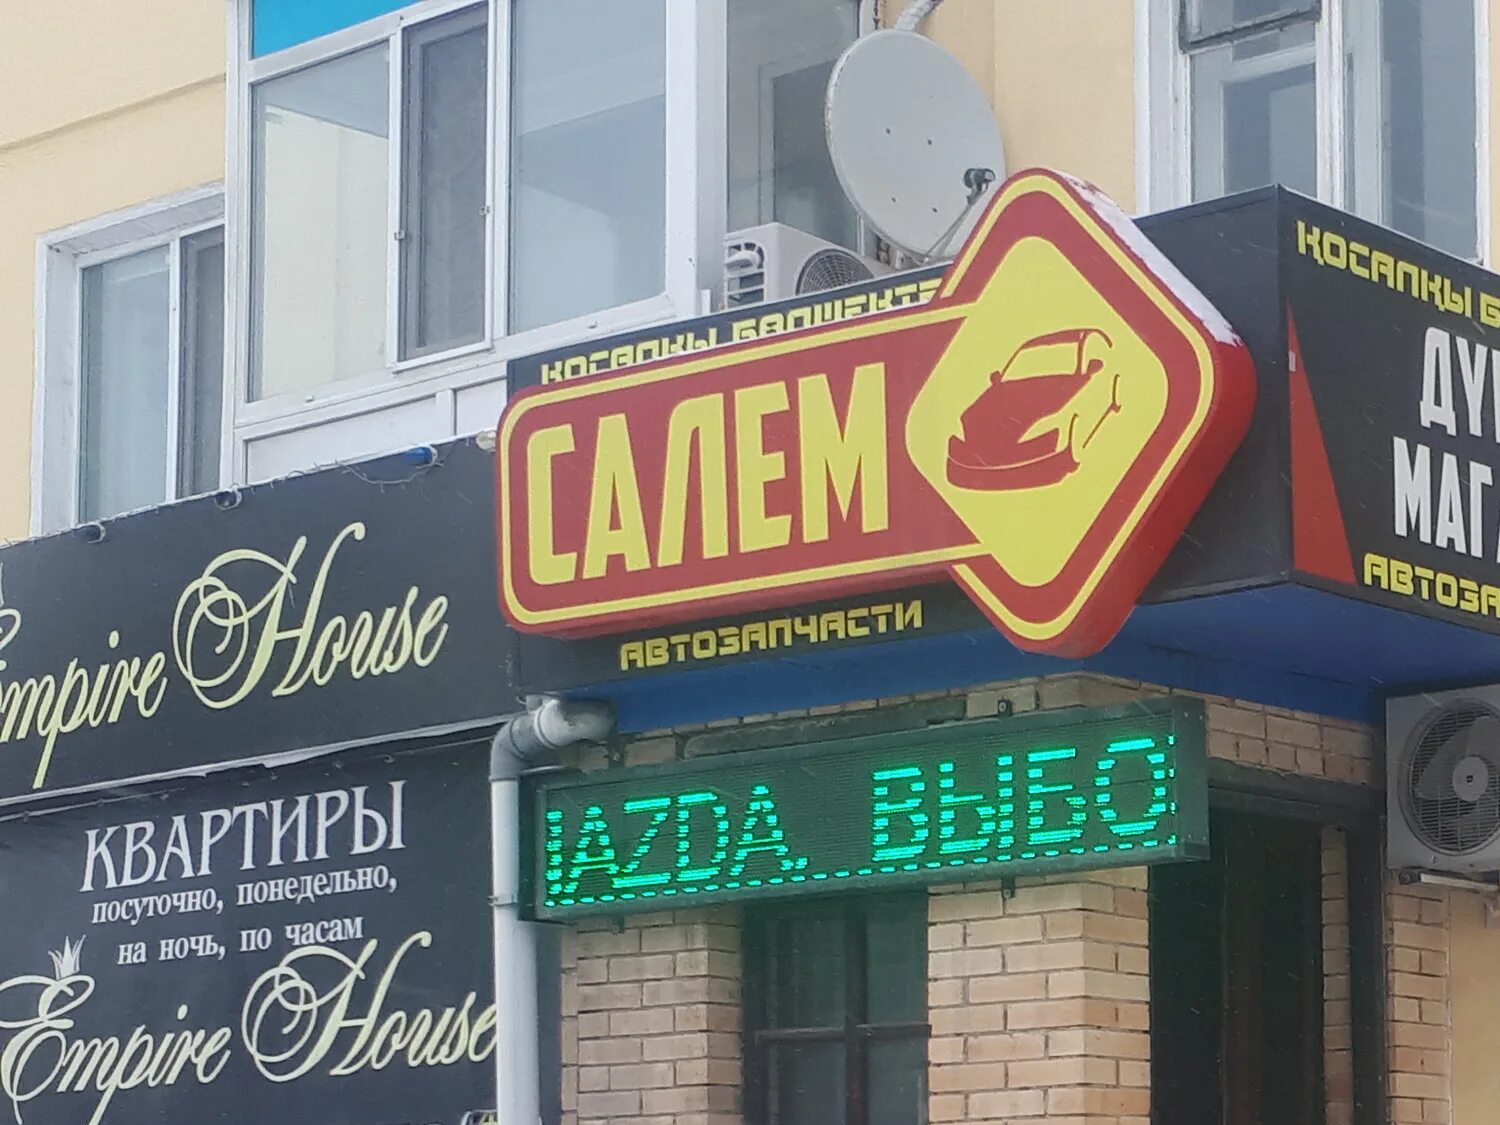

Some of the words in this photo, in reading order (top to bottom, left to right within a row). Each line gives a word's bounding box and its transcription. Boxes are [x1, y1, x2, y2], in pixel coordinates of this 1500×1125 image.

[528, 362, 888, 586] САЛЕМ
[173, 522, 448, 709] House
[619, 600, 923, 671] АВТОЗАПЧАСТИ
[80, 781, 405, 892] КВАРТИРЫ
[873, 735, 1175, 860] ВЫБО
[92, 887, 224, 924] посуточно,
[237, 864, 397, 906] понедельно,
[117, 941, 147, 965] на
[159, 933, 226, 961] ночь,
[240, 928, 272, 952] по
[285, 916, 364, 947] часам
[242, 931, 497, 1081] House
